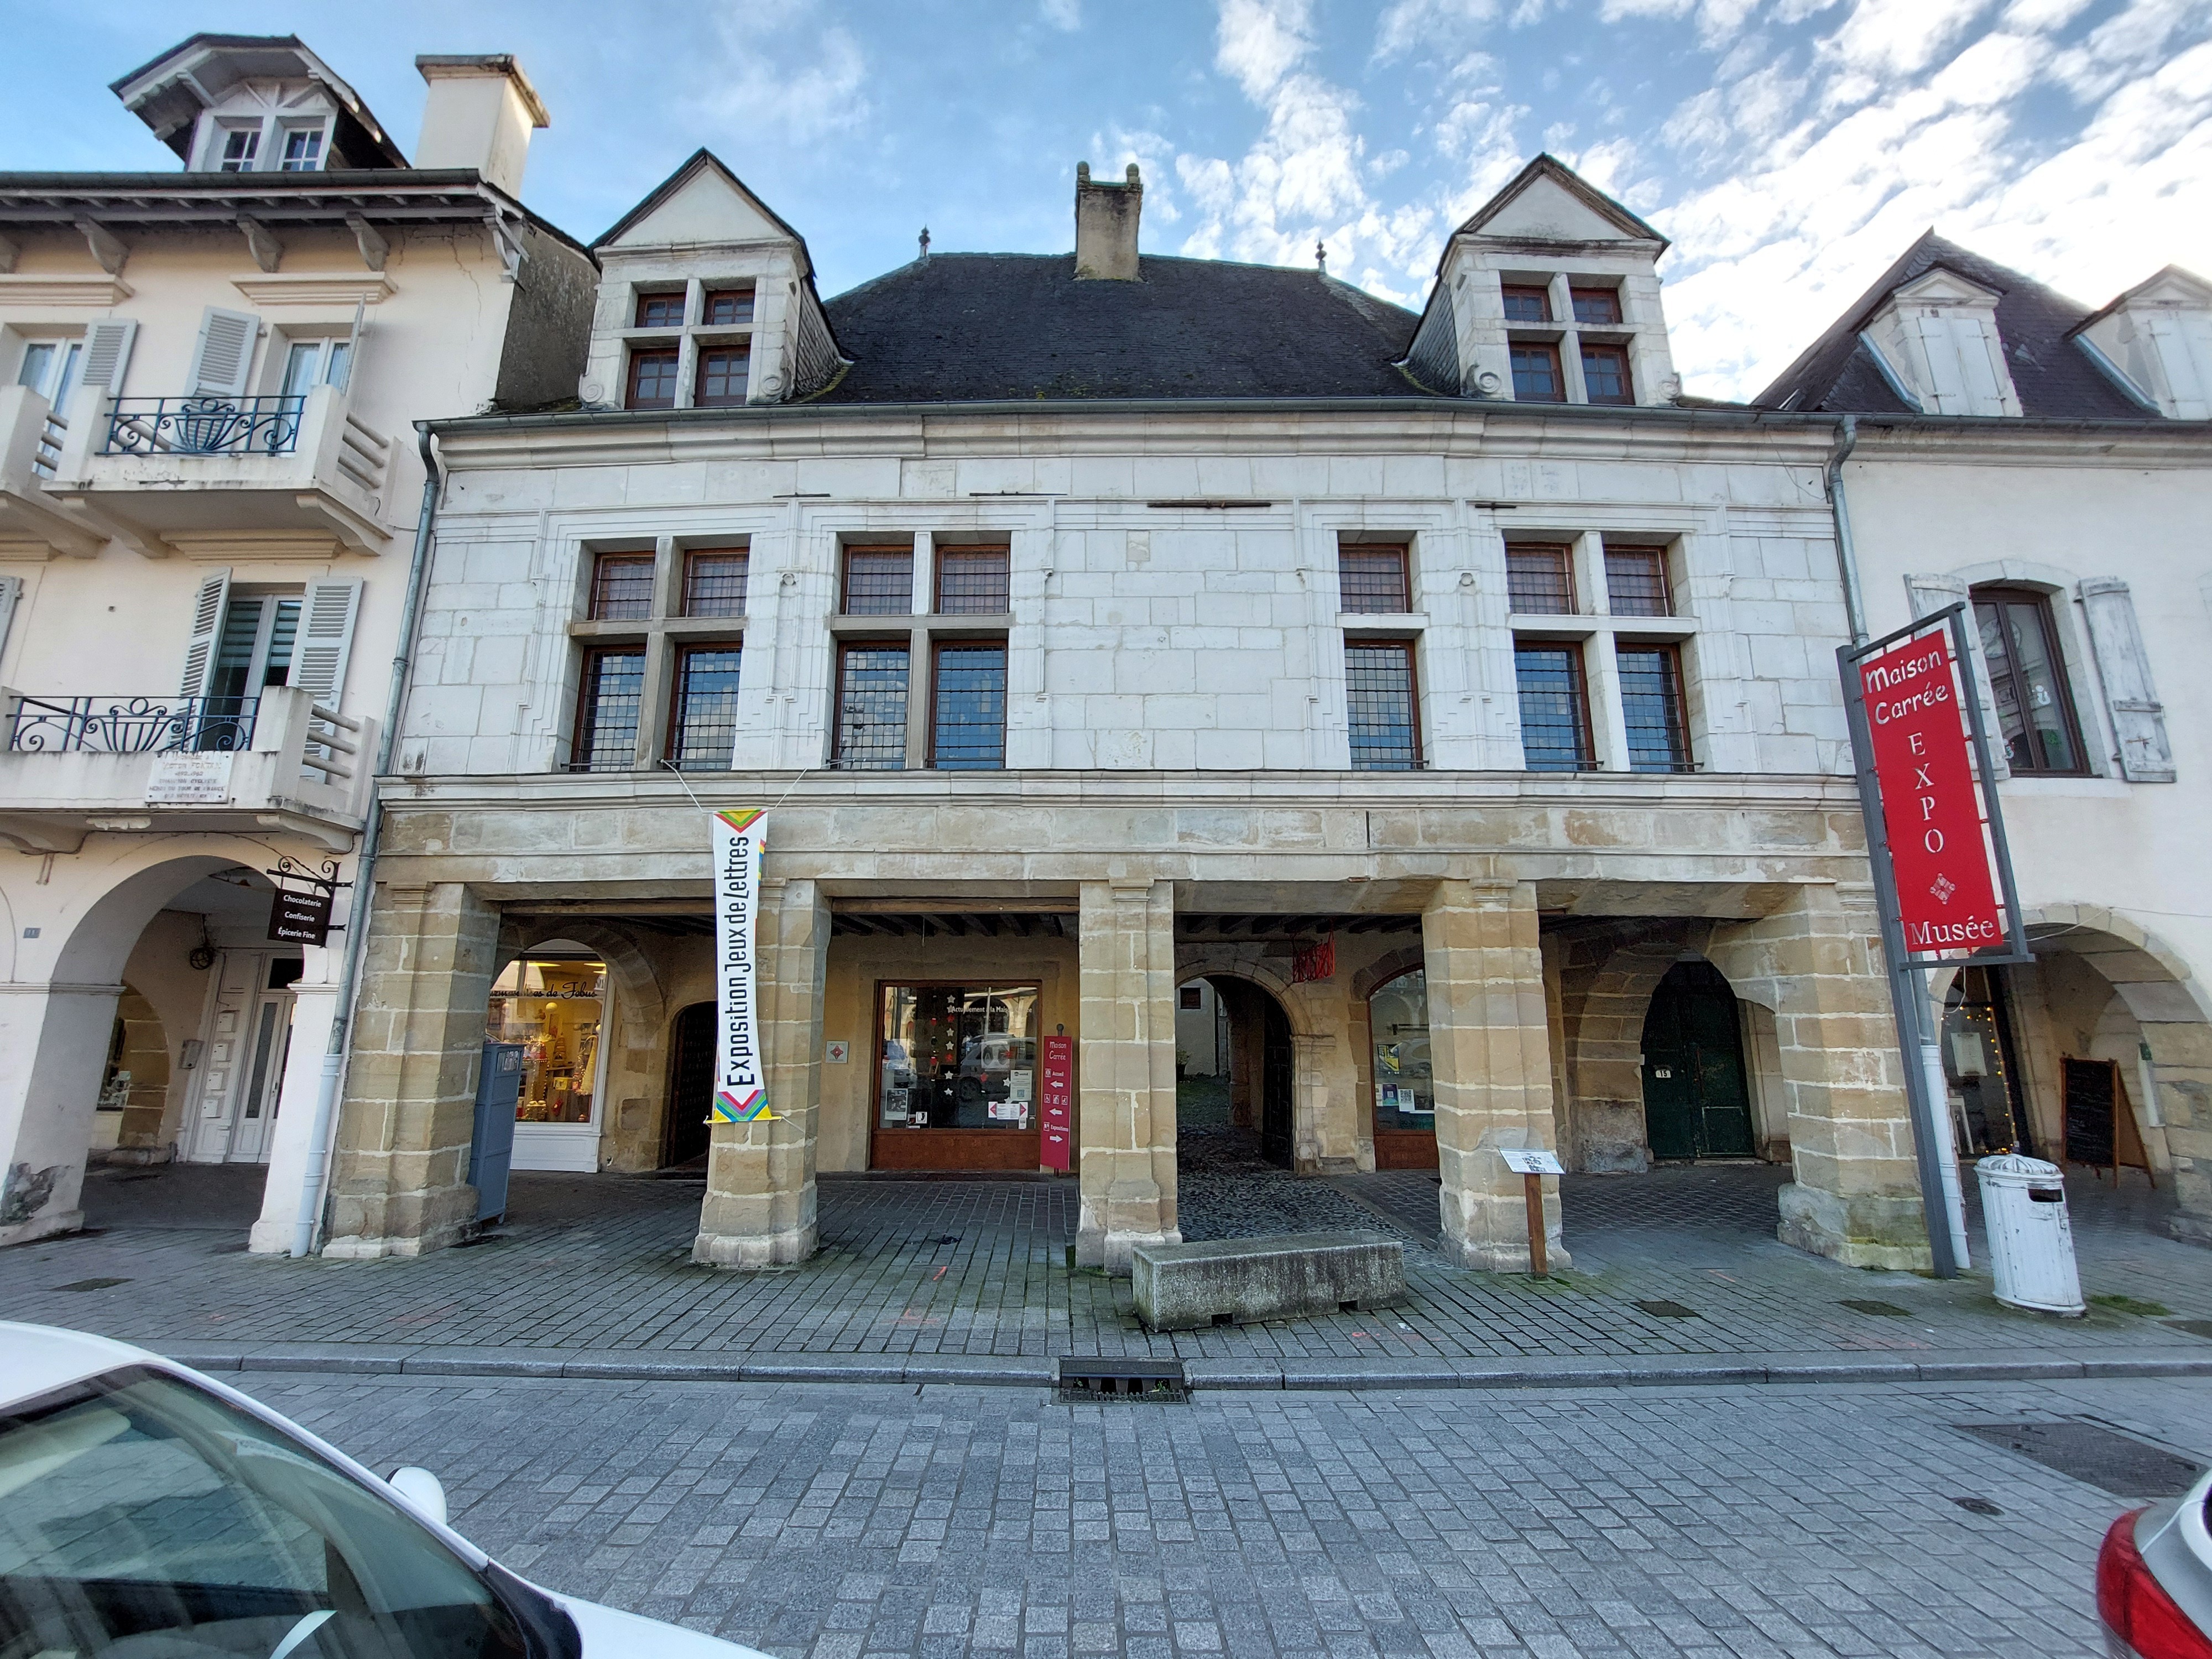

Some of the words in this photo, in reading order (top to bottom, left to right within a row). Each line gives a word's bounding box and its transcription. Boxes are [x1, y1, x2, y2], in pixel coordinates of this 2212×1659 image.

[1866, 650, 1942, 694] Maison
[1875, 681, 1949, 725] Carrée
[1907, 732, 1944, 853] EXPO
[723, 837, 749, 899] Lettres
[283, 894, 321, 907] Chocolaterie
[724, 902, 747, 924] de
[284, 911, 315, 922] Confiserie
[1908, 915, 1995, 945] Musée
[278, 926, 302, 937] Épicerie
[302, 931, 316, 939] Fine
[724, 927, 752, 973] Jeux
[546, 983, 560, 997] de
[561, 982, 597, 999] Febus
[724, 977, 755, 1086] Exposition
[1049, 1050, 1066, 1060] Carrée
